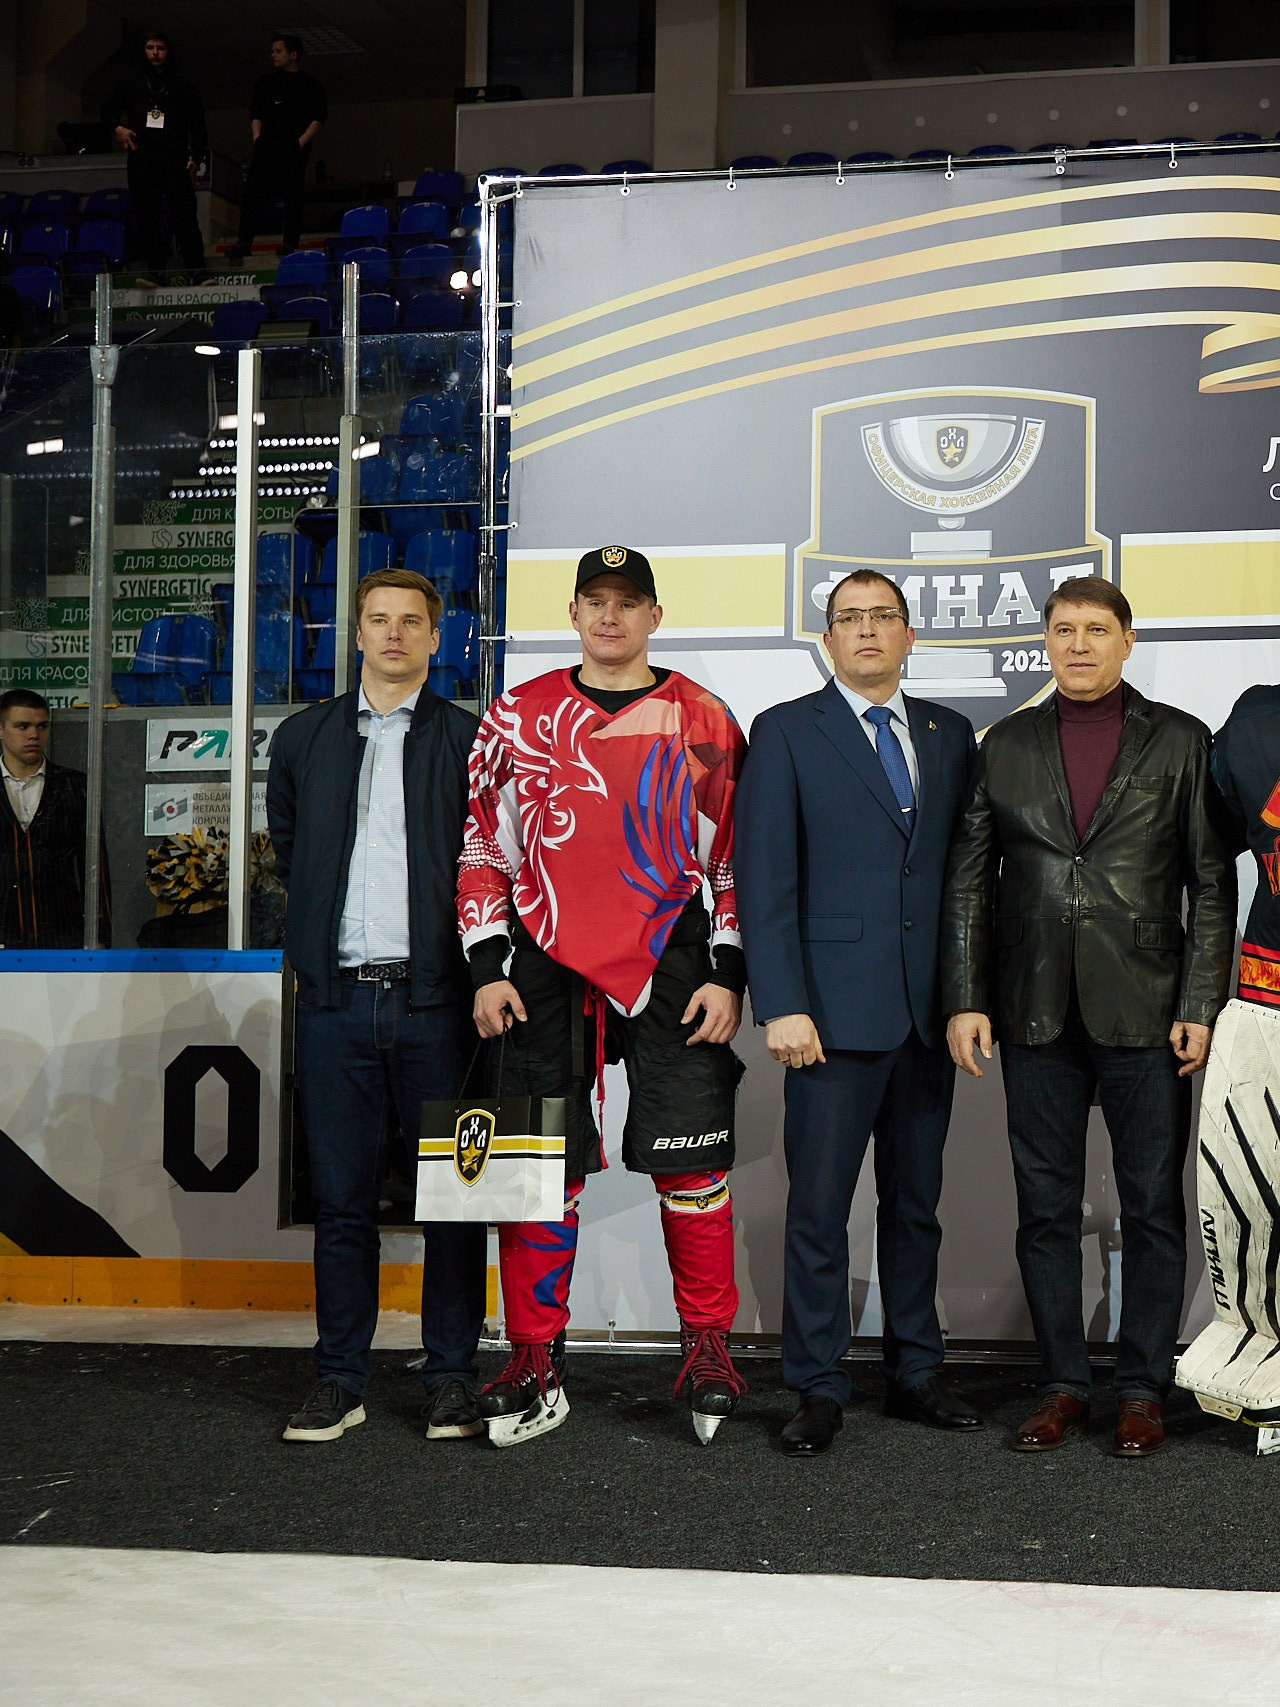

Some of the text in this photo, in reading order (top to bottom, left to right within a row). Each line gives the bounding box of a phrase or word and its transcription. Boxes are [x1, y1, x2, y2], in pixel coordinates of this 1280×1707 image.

[867, 427, 1039, 508] ОФИЦЕРСКАЯ ХОККЕЙНАЯ ЛИГА
[192, 507, 220, 521] ДЛЯ
[124, 553, 236, 570] ДЛЯ ЗДОРОВЬЯ
[119, 577, 212, 598] SYNERGETIC
[62, 608, 91, 623] ДЛЯ
[1001, 649, 1052, 672] 2025
[0, 665, 90, 682] ДЛЯ КРАСО
[652, 1129, 729, 1150] BAUER
